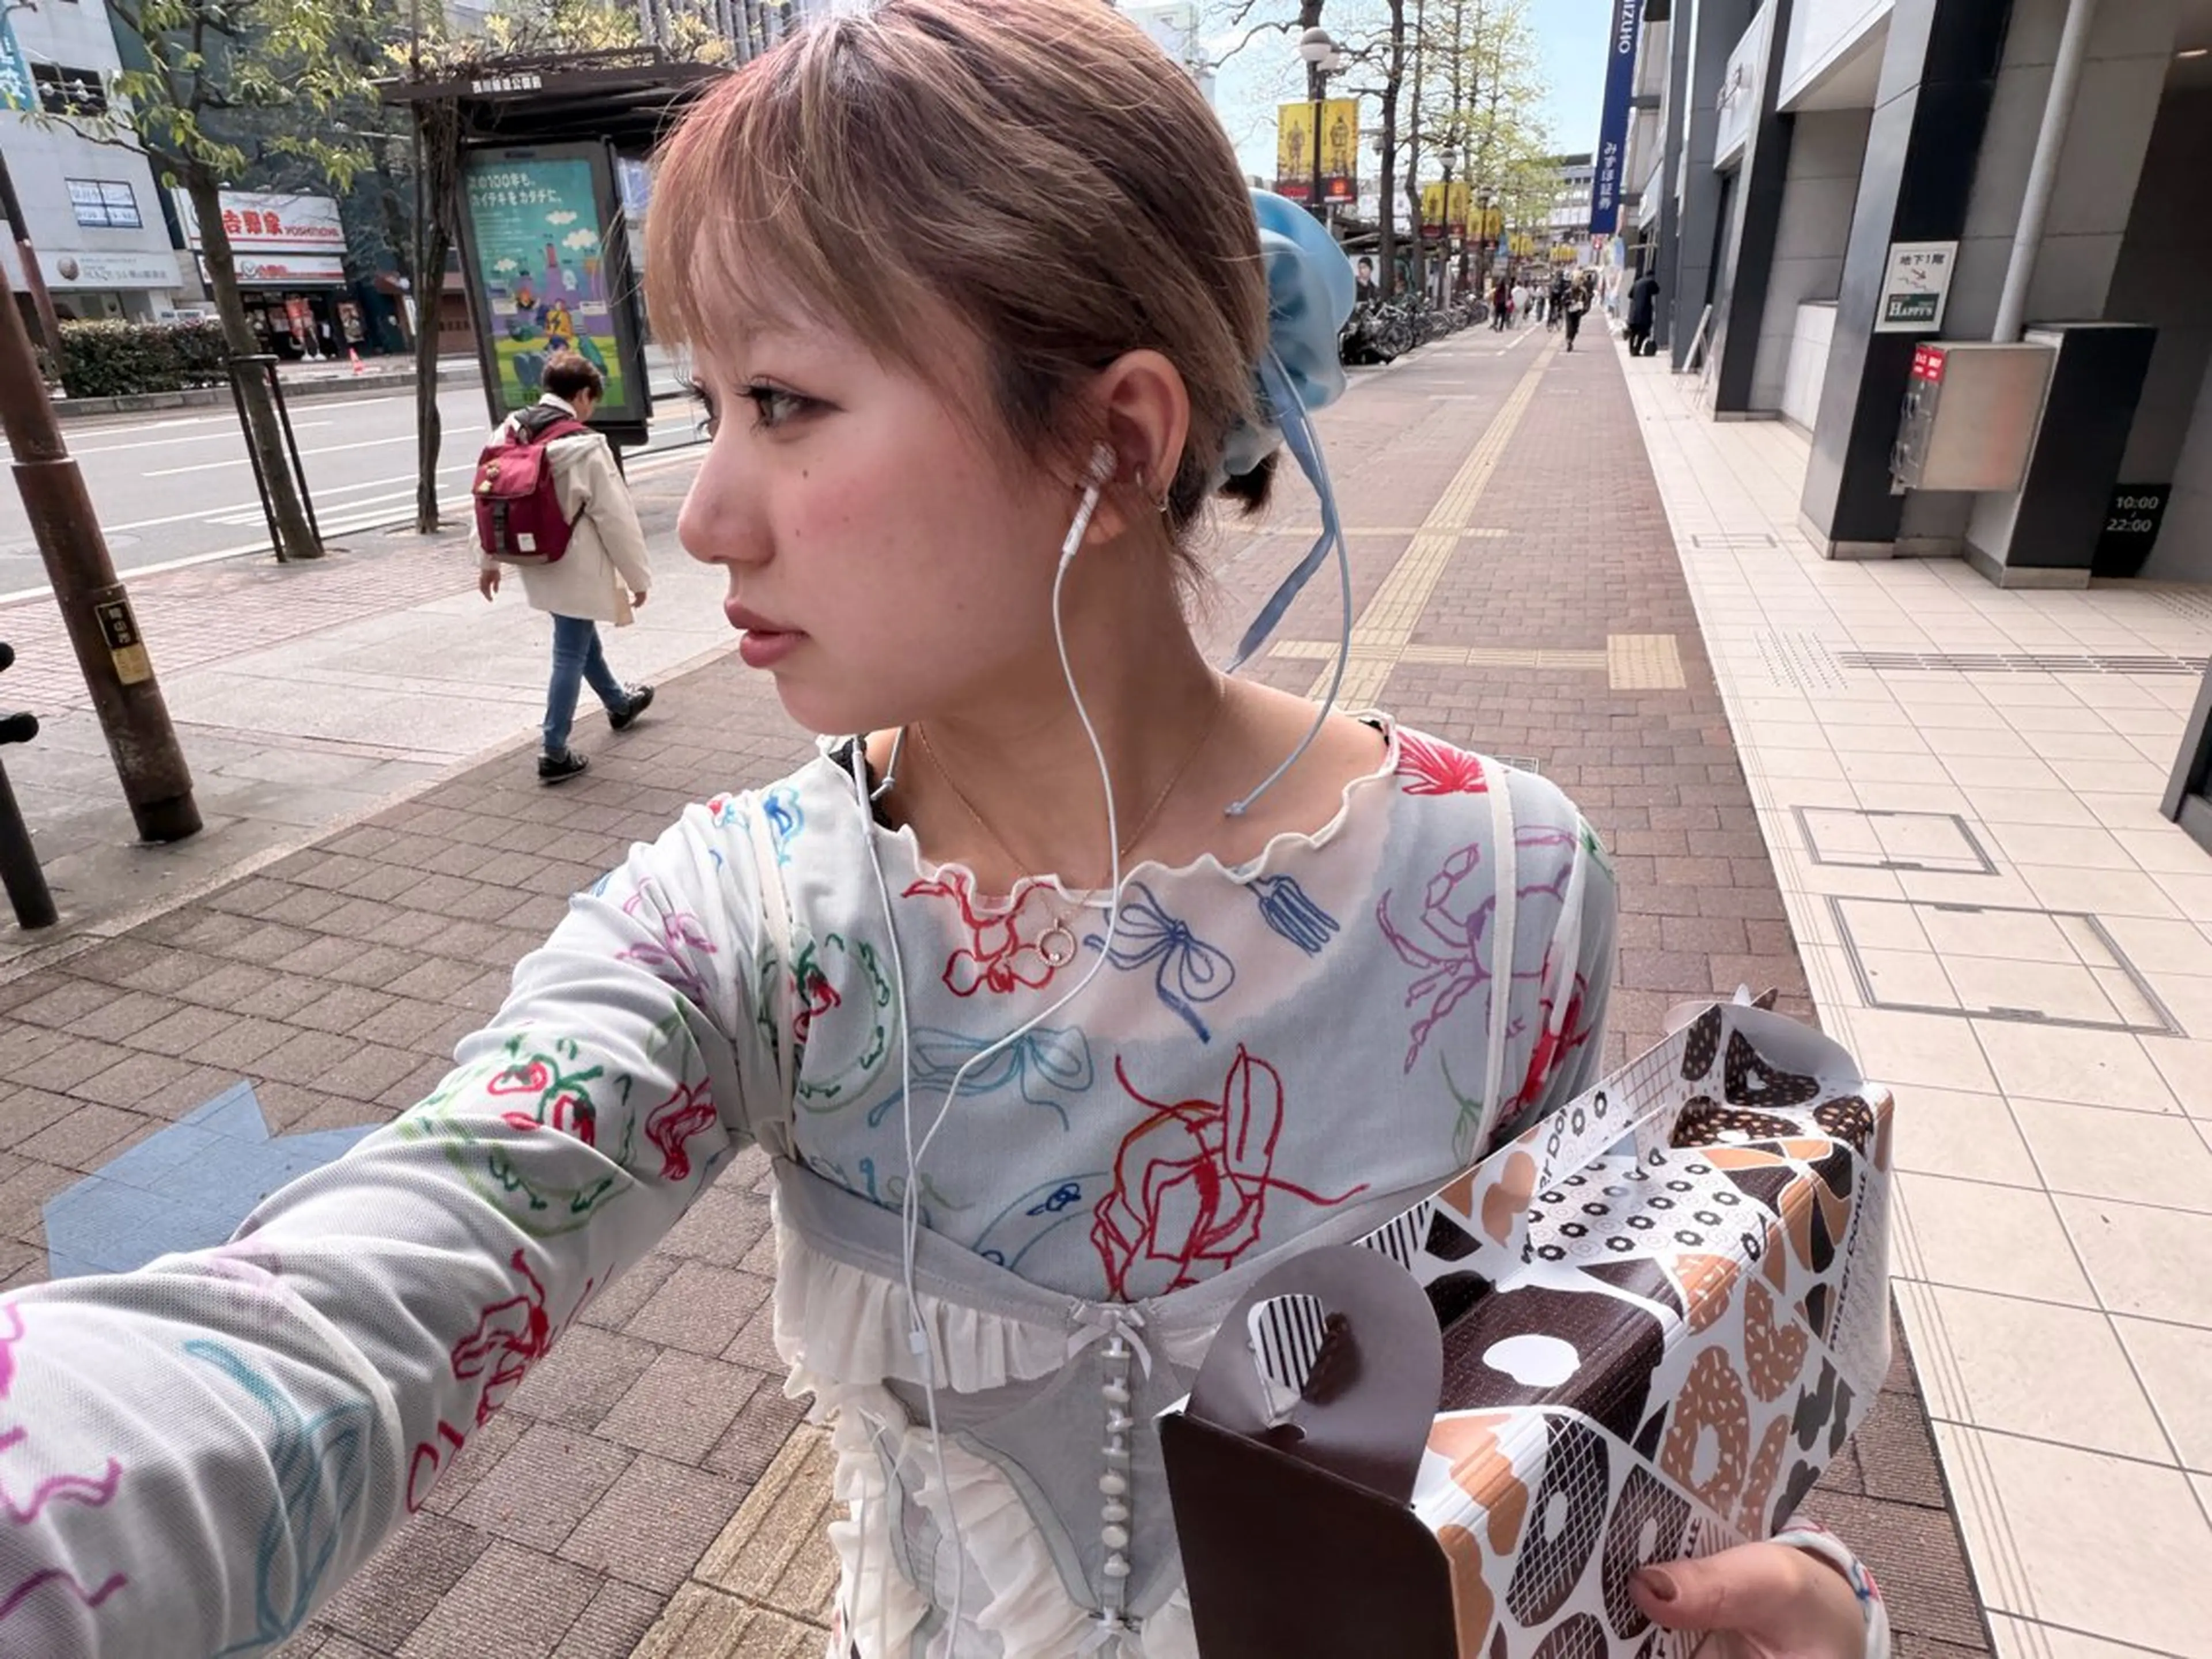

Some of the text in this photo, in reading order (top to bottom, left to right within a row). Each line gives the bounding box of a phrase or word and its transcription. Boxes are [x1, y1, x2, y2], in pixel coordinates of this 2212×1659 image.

[1618, 0, 1635, 54] IZUHO
[2116, 495, 2159, 509] 10:00
[2107, 518, 2152, 532] 22:00
